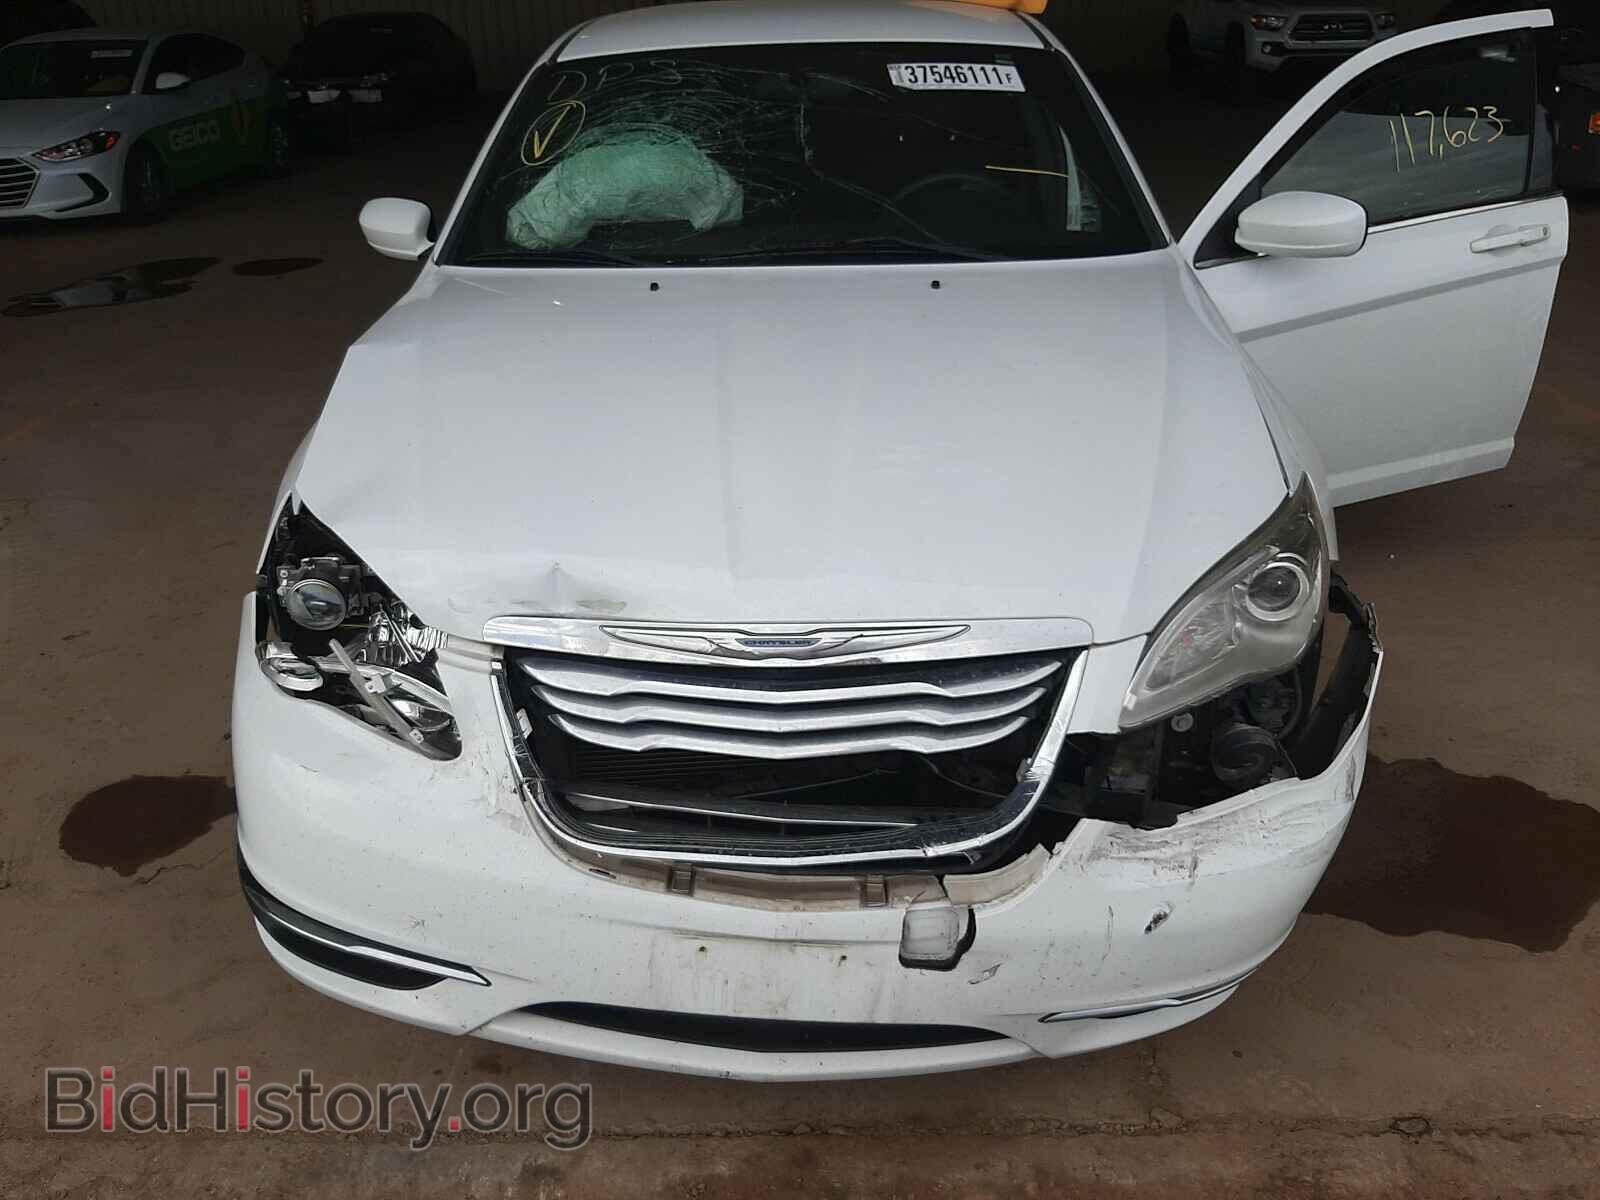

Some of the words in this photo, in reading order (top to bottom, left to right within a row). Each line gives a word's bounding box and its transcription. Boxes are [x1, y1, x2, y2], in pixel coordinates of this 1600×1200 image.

[904, 64, 1003, 85] 37546111
[168, 120, 221, 152] GEICO
[1389, 105, 1504, 173] 117,623
